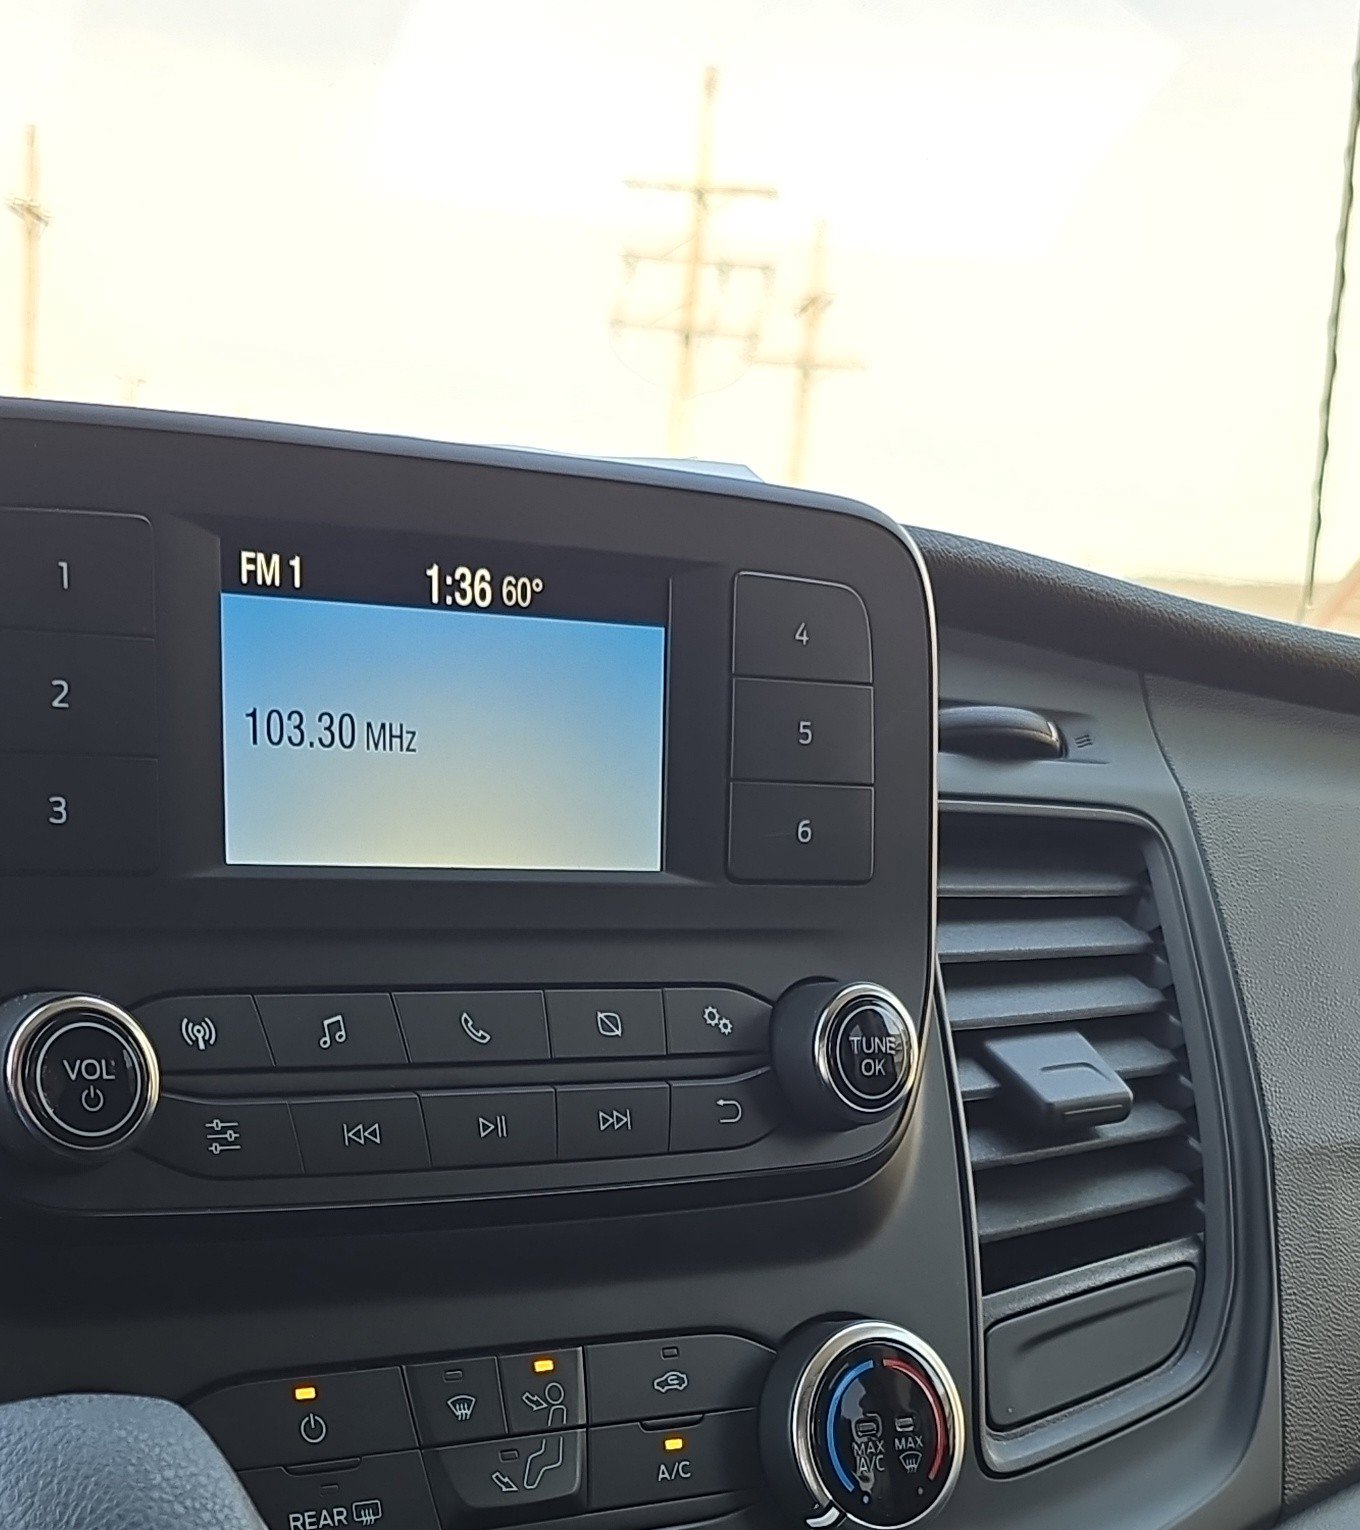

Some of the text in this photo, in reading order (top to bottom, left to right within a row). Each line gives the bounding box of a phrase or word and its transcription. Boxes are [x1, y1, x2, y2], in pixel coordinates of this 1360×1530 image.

[58, 561, 68, 590] 1
[240, 550, 302, 589] FM 1
[425, 563, 491, 608] 1:36
[794, 622, 810, 646] 4
[51, 679, 70, 708] 2
[245, 707, 417, 753] 103.30 MHz
[798, 720, 813, 745] 5
[48, 796, 67, 824] 3
[797, 819, 813, 843] 6
[848, 1035, 896, 1055] TUNE
[63, 1059, 116, 1081] VOL
[861, 1058, 886, 1076] OK
[852, 1440, 885, 1456] MAX
[895, 1435, 924, 1451] MAX
[658, 1461, 692, 1482] A/C
[858, 1455, 885, 1472] A/C
